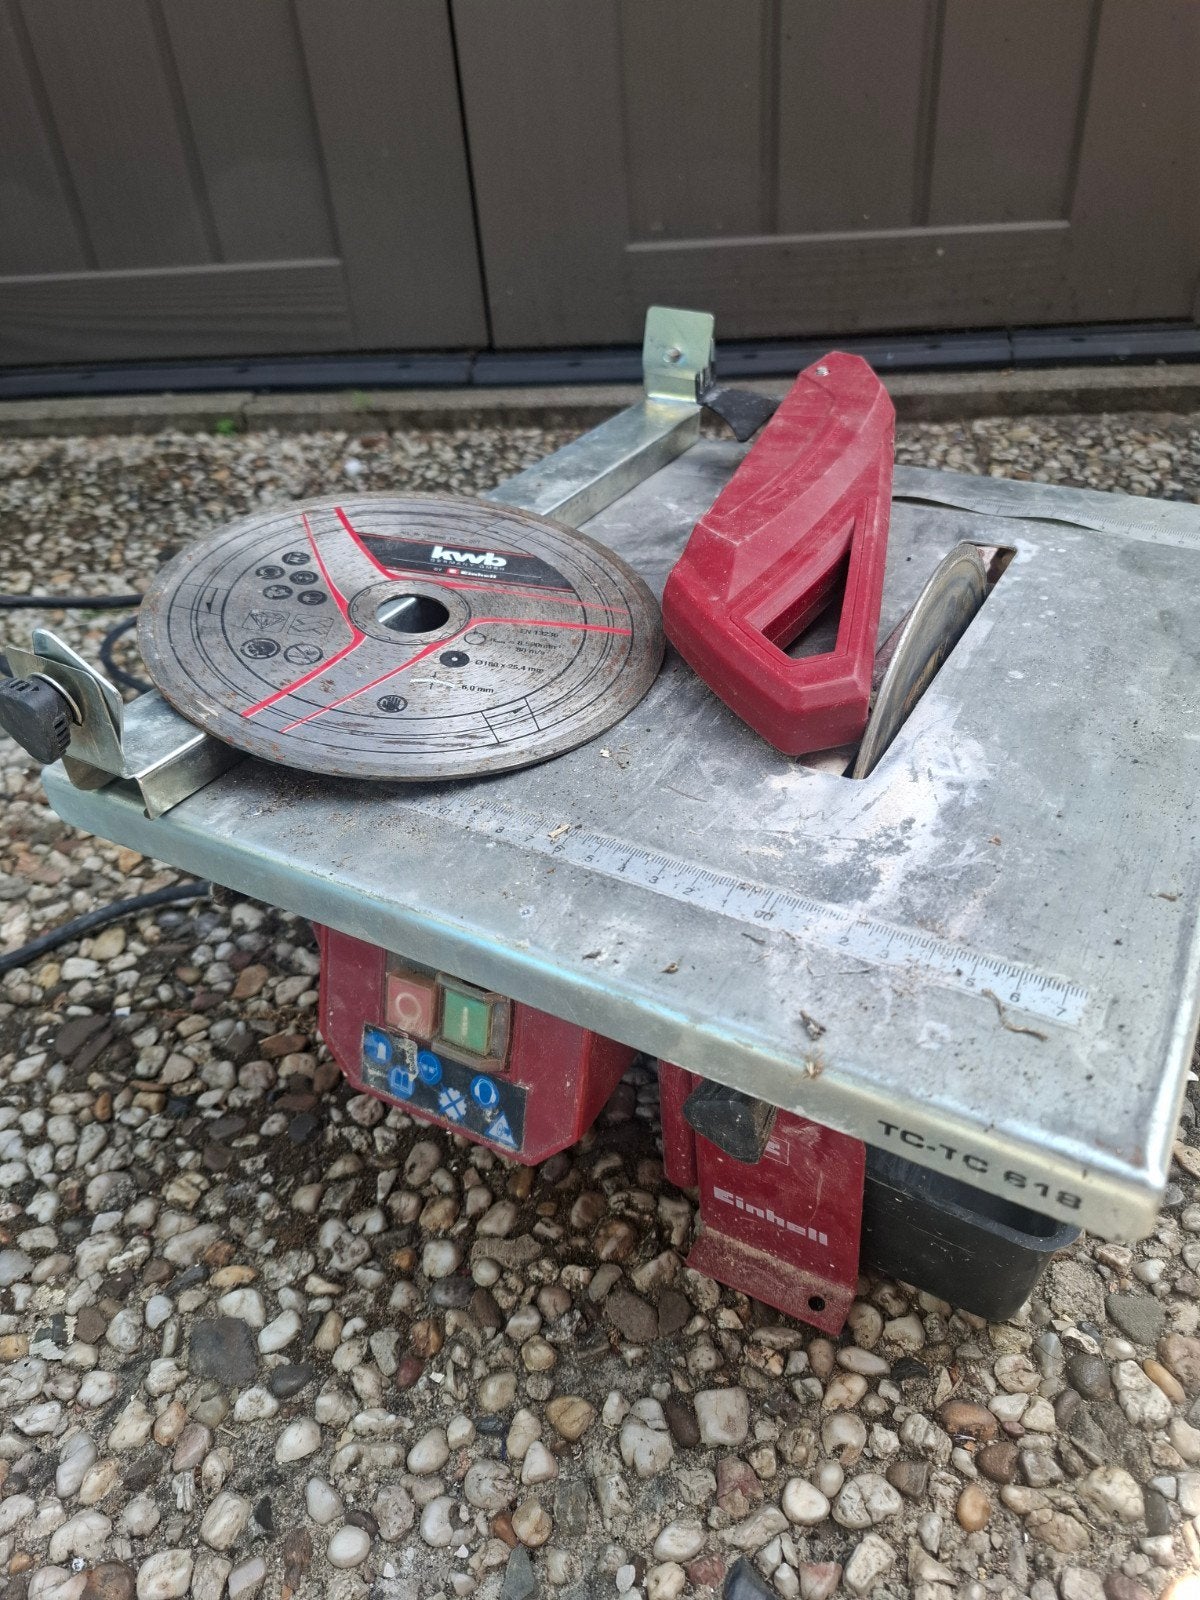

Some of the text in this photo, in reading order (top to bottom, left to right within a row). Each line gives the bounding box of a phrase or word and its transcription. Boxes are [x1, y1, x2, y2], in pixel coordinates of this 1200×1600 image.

[431, 546, 507, 567] kwb
[584, 854, 594, 863] 5
[648, 876, 659, 884] 3
[682, 887, 693, 896] 2
[838, 937, 849, 946] 2
[965, 978, 976, 987] 5
[1009, 992, 1021, 1003] 6
[1056, 1007, 1067, 1017] 7
[877, 1119, 1082, 1209] TC-TC 618
[713, 1186, 828, 1246] Einhell
